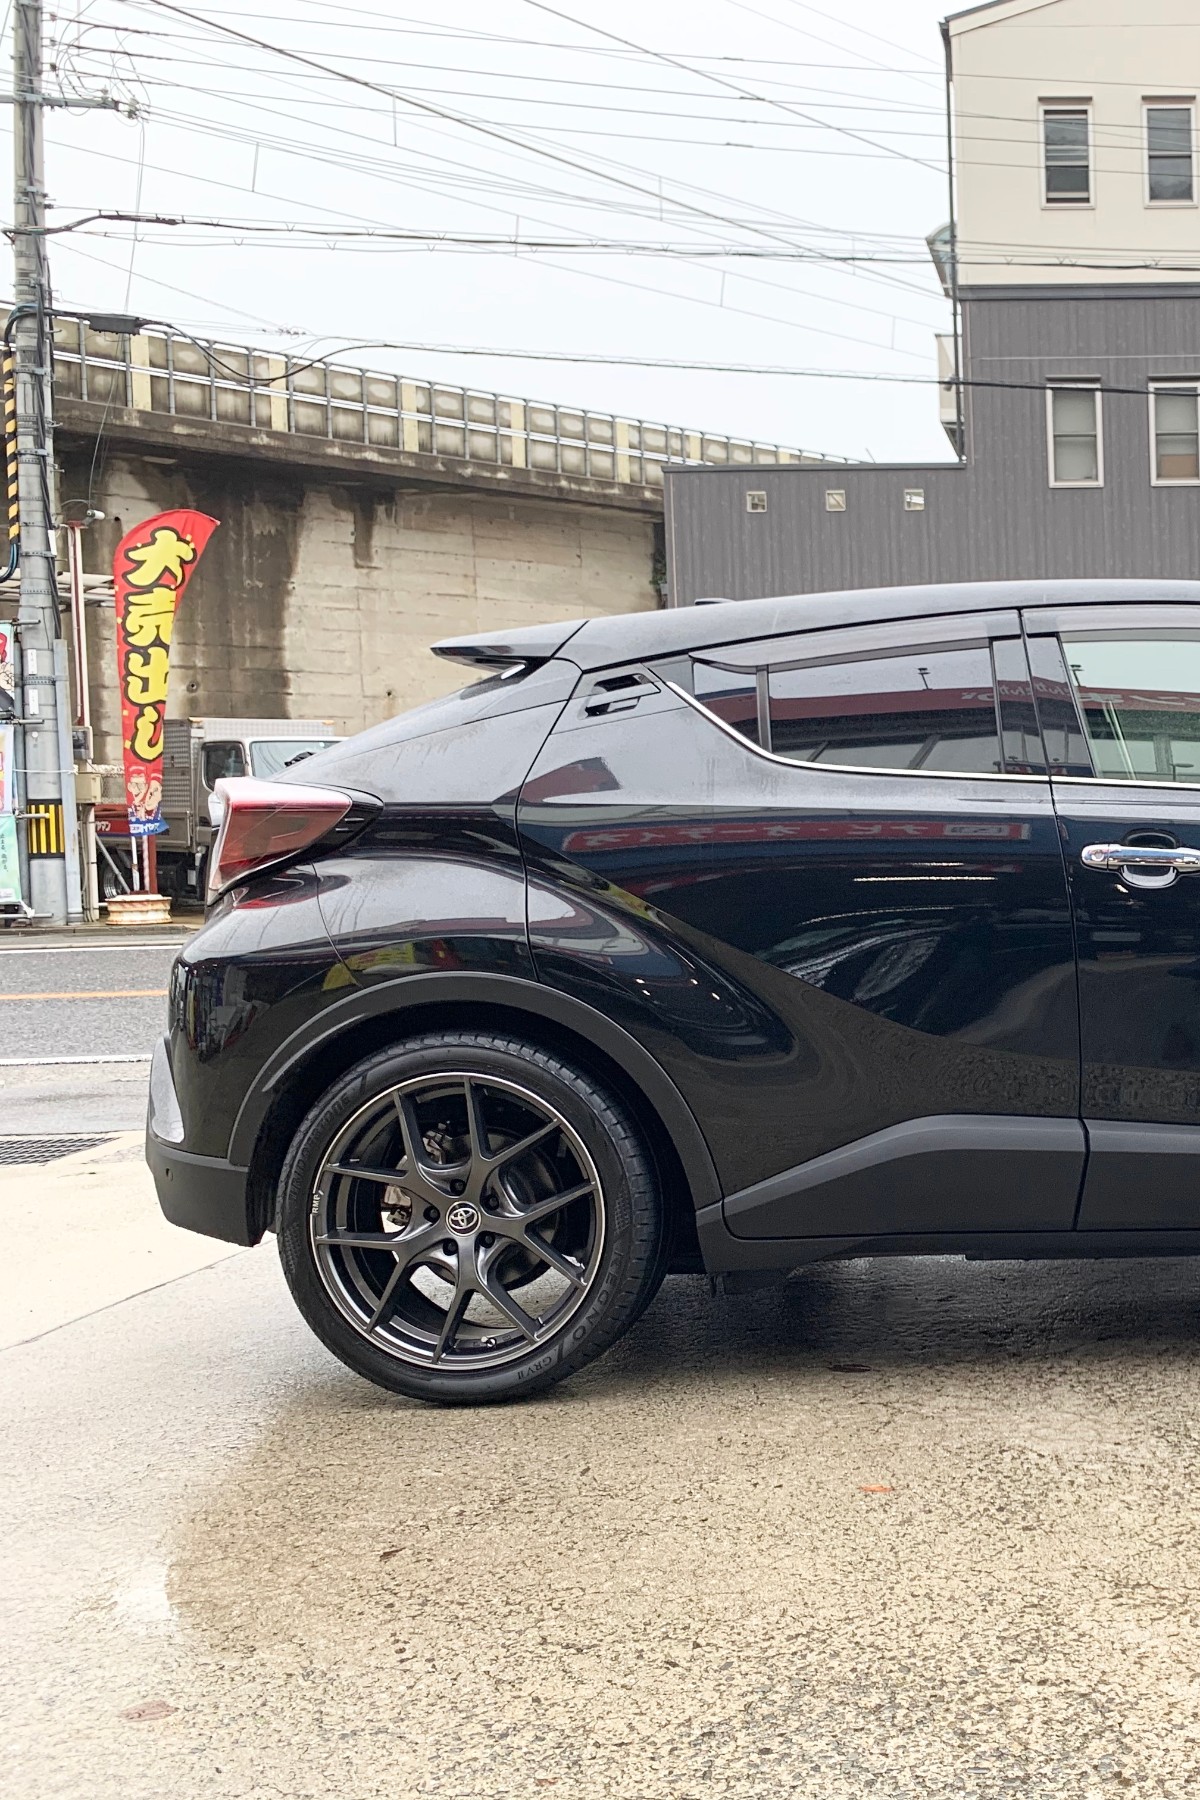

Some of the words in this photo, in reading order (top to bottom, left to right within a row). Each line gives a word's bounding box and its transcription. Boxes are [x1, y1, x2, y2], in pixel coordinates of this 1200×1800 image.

[122, 526, 198, 764] 大売出し
[311, 1194, 321, 1214] RMP
